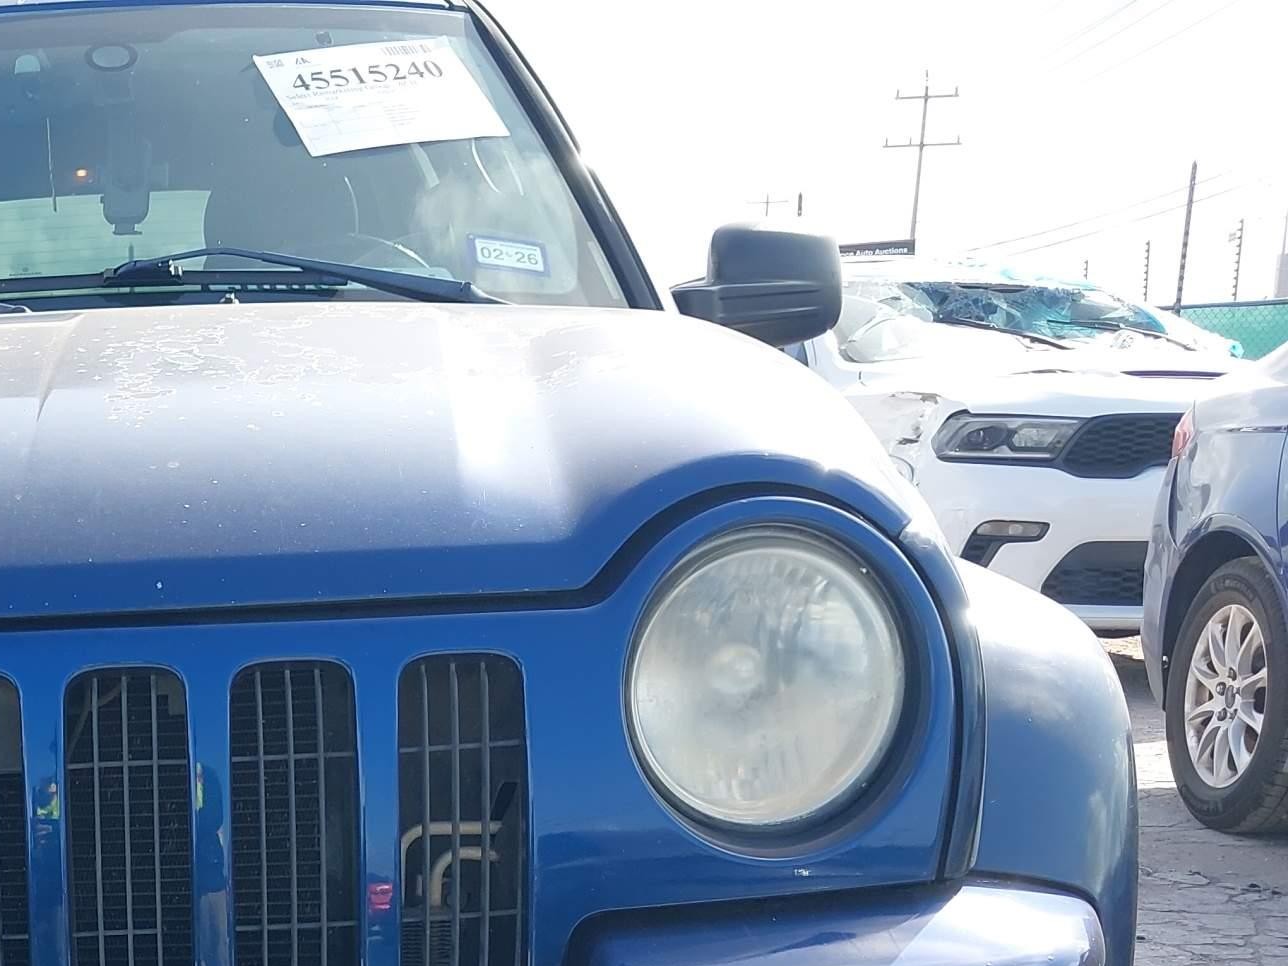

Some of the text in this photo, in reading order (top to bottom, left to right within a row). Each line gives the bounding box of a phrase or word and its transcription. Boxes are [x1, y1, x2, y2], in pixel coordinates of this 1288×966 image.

[292, 59, 444, 91] 45515240
[480, 246, 505, 261] 02
[515, 251, 539, 265] 26
[874, 247, 908, 256] Auctions
